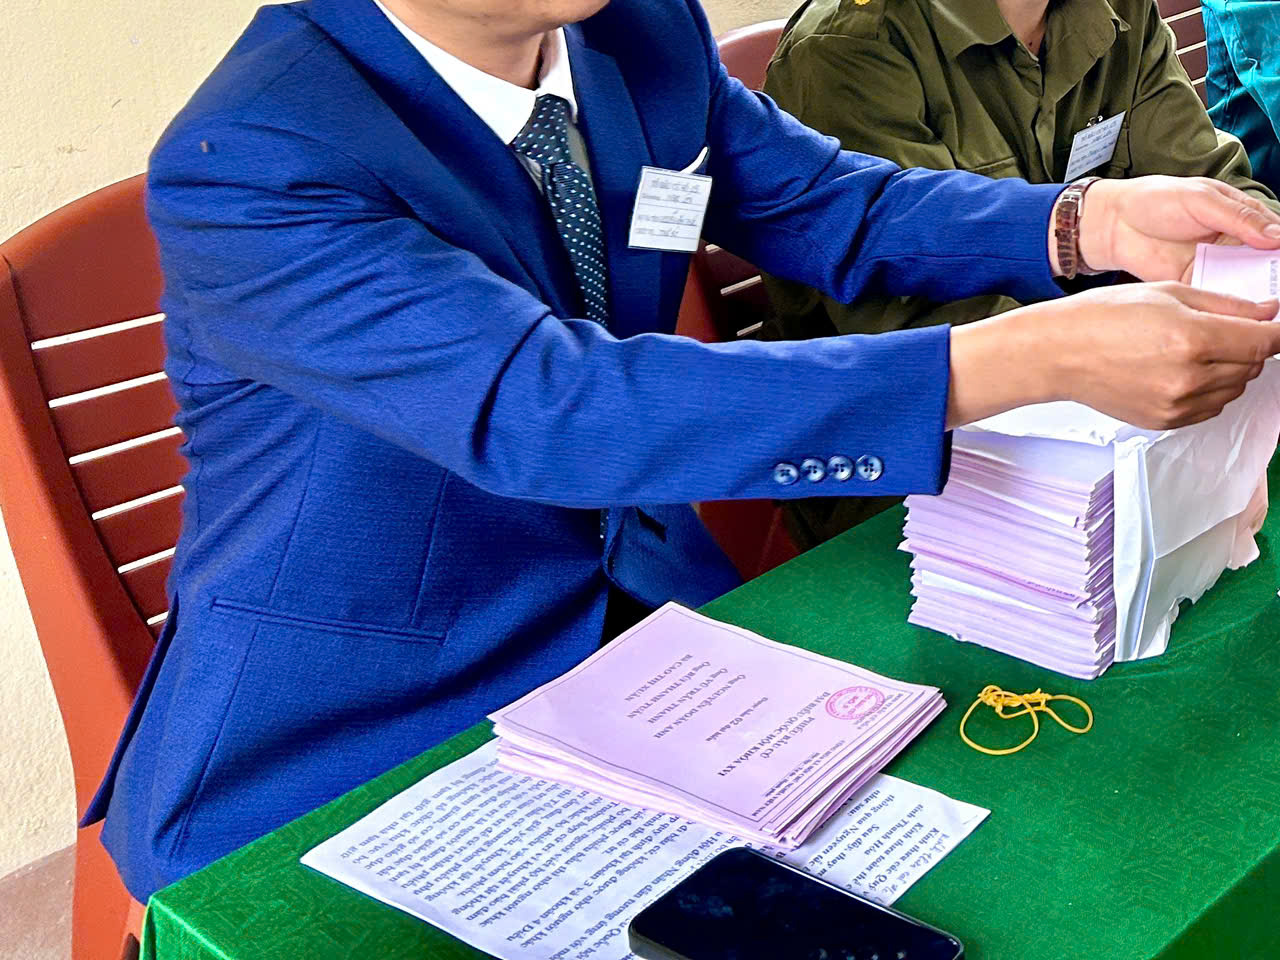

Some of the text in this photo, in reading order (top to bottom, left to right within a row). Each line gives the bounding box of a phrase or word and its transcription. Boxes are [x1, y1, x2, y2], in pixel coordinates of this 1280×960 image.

[662, 661, 682, 675] CAO
[691, 660, 711, 672] Ông
[709, 667, 728, 678] Ông
[646, 674, 666, 685] THỊ
[726, 673, 746, 685] Ông
[623, 684, 650, 701] XUÂN
[649, 681, 682, 702] THANH
[696, 684, 731, 709] NGUYỄN
[647, 702, 679, 723] THANH
[728, 716, 743, 725] 02
[653, 724, 673, 738] ANH
[773, 715, 798, 734] QUỐC
[757, 733, 776, 746] HỘI
[759, 716, 815, 759] PHIẾU BẦU CỬ
[732, 745, 760, 763] KHÓA
[717, 764, 736, 776] XVI
[615, 806, 631, 816] bỏ
[846, 789, 880, 816] như sau:
[869, 793, 895, 813] thông
[855, 811, 872, 825] qua
[651, 822, 670, 835] quy
[881, 818, 909, 839] Thanh
[412, 788, 571, 895] thì Tổ bầu cử mang hòm phiếu phụ
[423, 789, 590, 901] tri ốm đau, già yếu, khuyết tật không
[560, 832, 589, 853] người
[601, 845, 618, 854] tri.
[615, 836, 629, 846] cử
[630, 834, 653, 850] định
[826, 823, 880, 868] Sau đây, thay
[863, 839, 884, 855] Hóa
[450, 801, 620, 915] Trường hợp cử tri vì khuyết tật không
[456, 804, 592, 896] khác bỏ phiếu vào hòm phiếu.
[618, 849, 633, 859] tại
[852, 821, 924, 886] Kính thưa toàn thể
[867, 826, 940, 891] Kính thưa các Quý
[478, 807, 648, 927] viết được phiếu bầu thì nhờ người khác
[541, 852, 562, 867] viết
[808, 854, 823, 867] tắc
[528, 866, 545, 877] hộ
[589, 858, 622, 880] khoản
[506, 875, 529, 894] phải
[519, 824, 687, 948] đi bầu cử, không được nhờ người khác
[568, 886, 584, 896] và
[582, 879, 593, 887] 3
[488, 892, 510, 906] bảo
[568, 836, 718, 948] Hội đồng Nhân dân tương ứng với
[465, 905, 489, 921] đảm
[539, 895, 572, 919] khoản
[505, 923, 534, 941] Điều
[575, 927, 621, 960] Quốc hội
